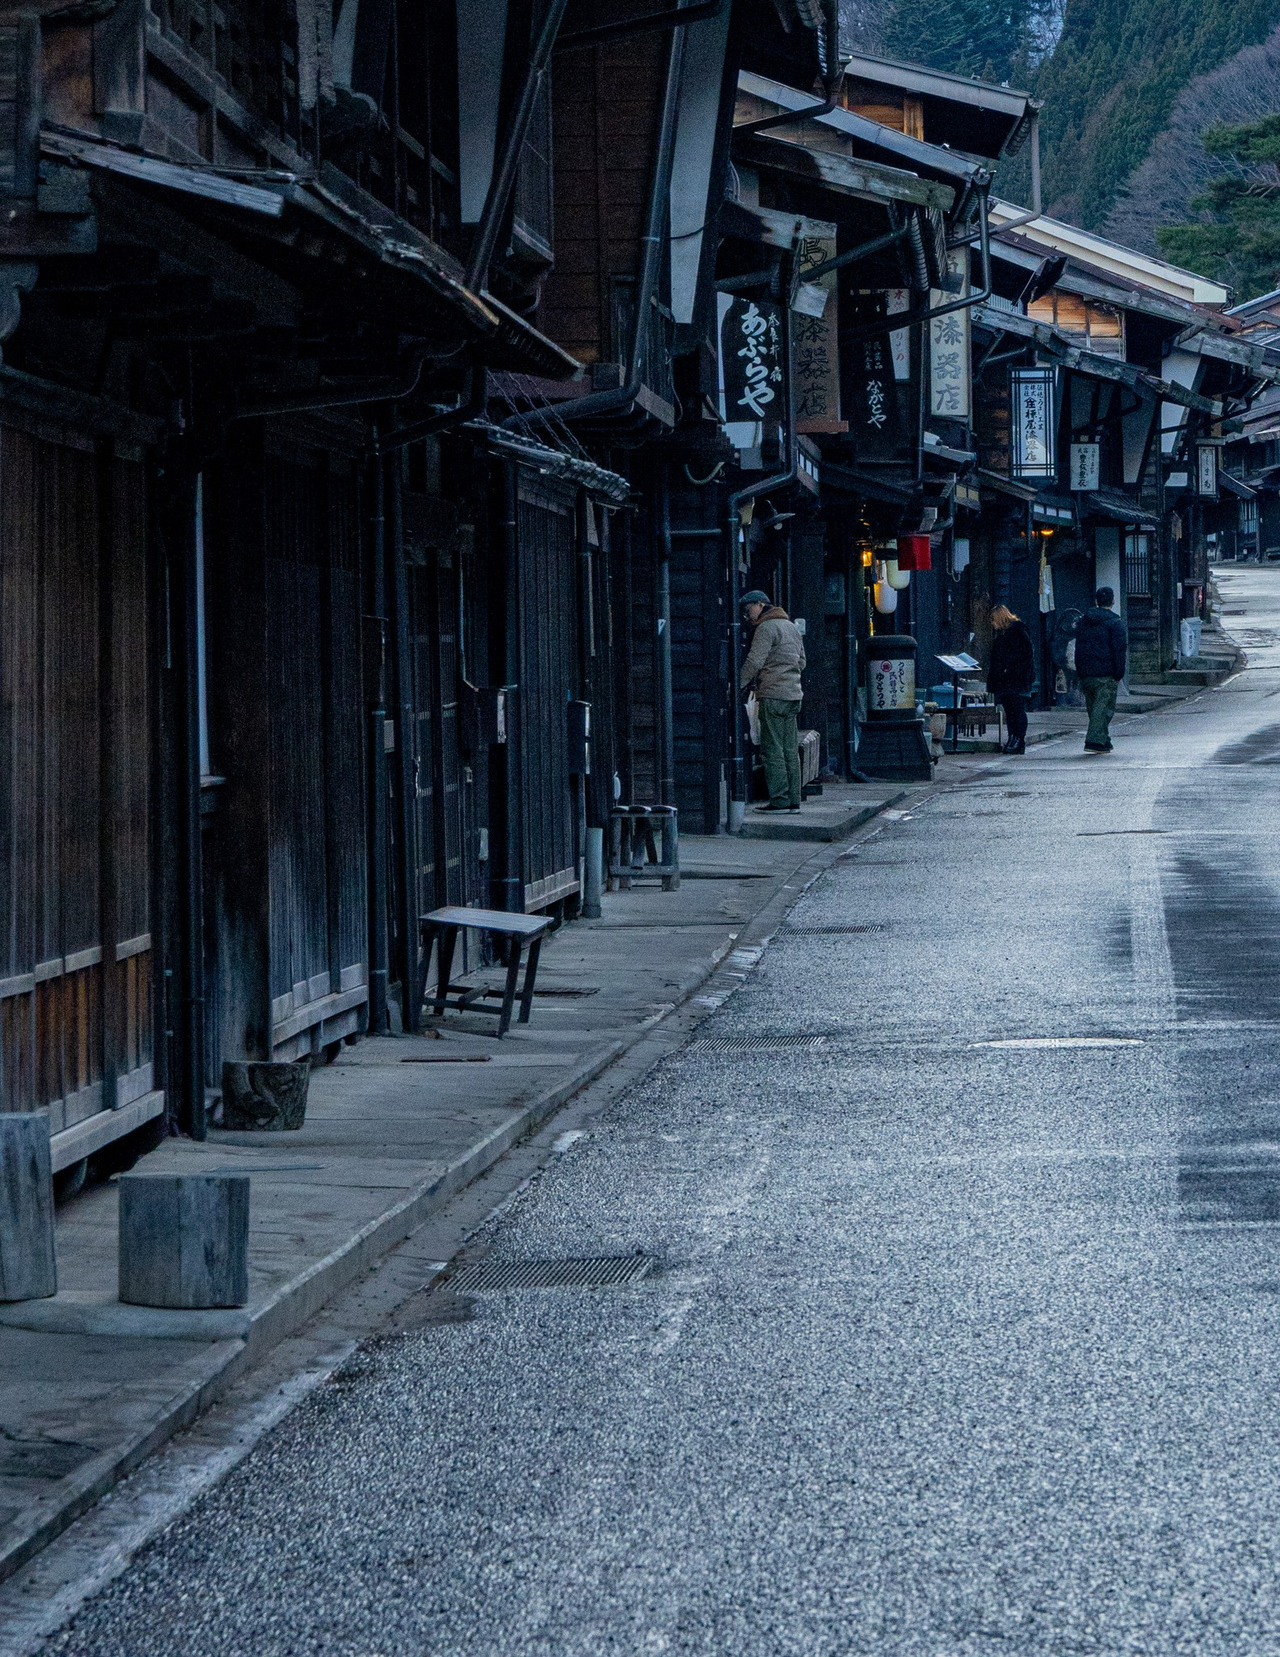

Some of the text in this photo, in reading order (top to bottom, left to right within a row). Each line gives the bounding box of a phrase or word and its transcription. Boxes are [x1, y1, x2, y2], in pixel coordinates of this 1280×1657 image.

[737, 302, 775, 418] あぶらや
[866, 379, 887, 429] ながとや
